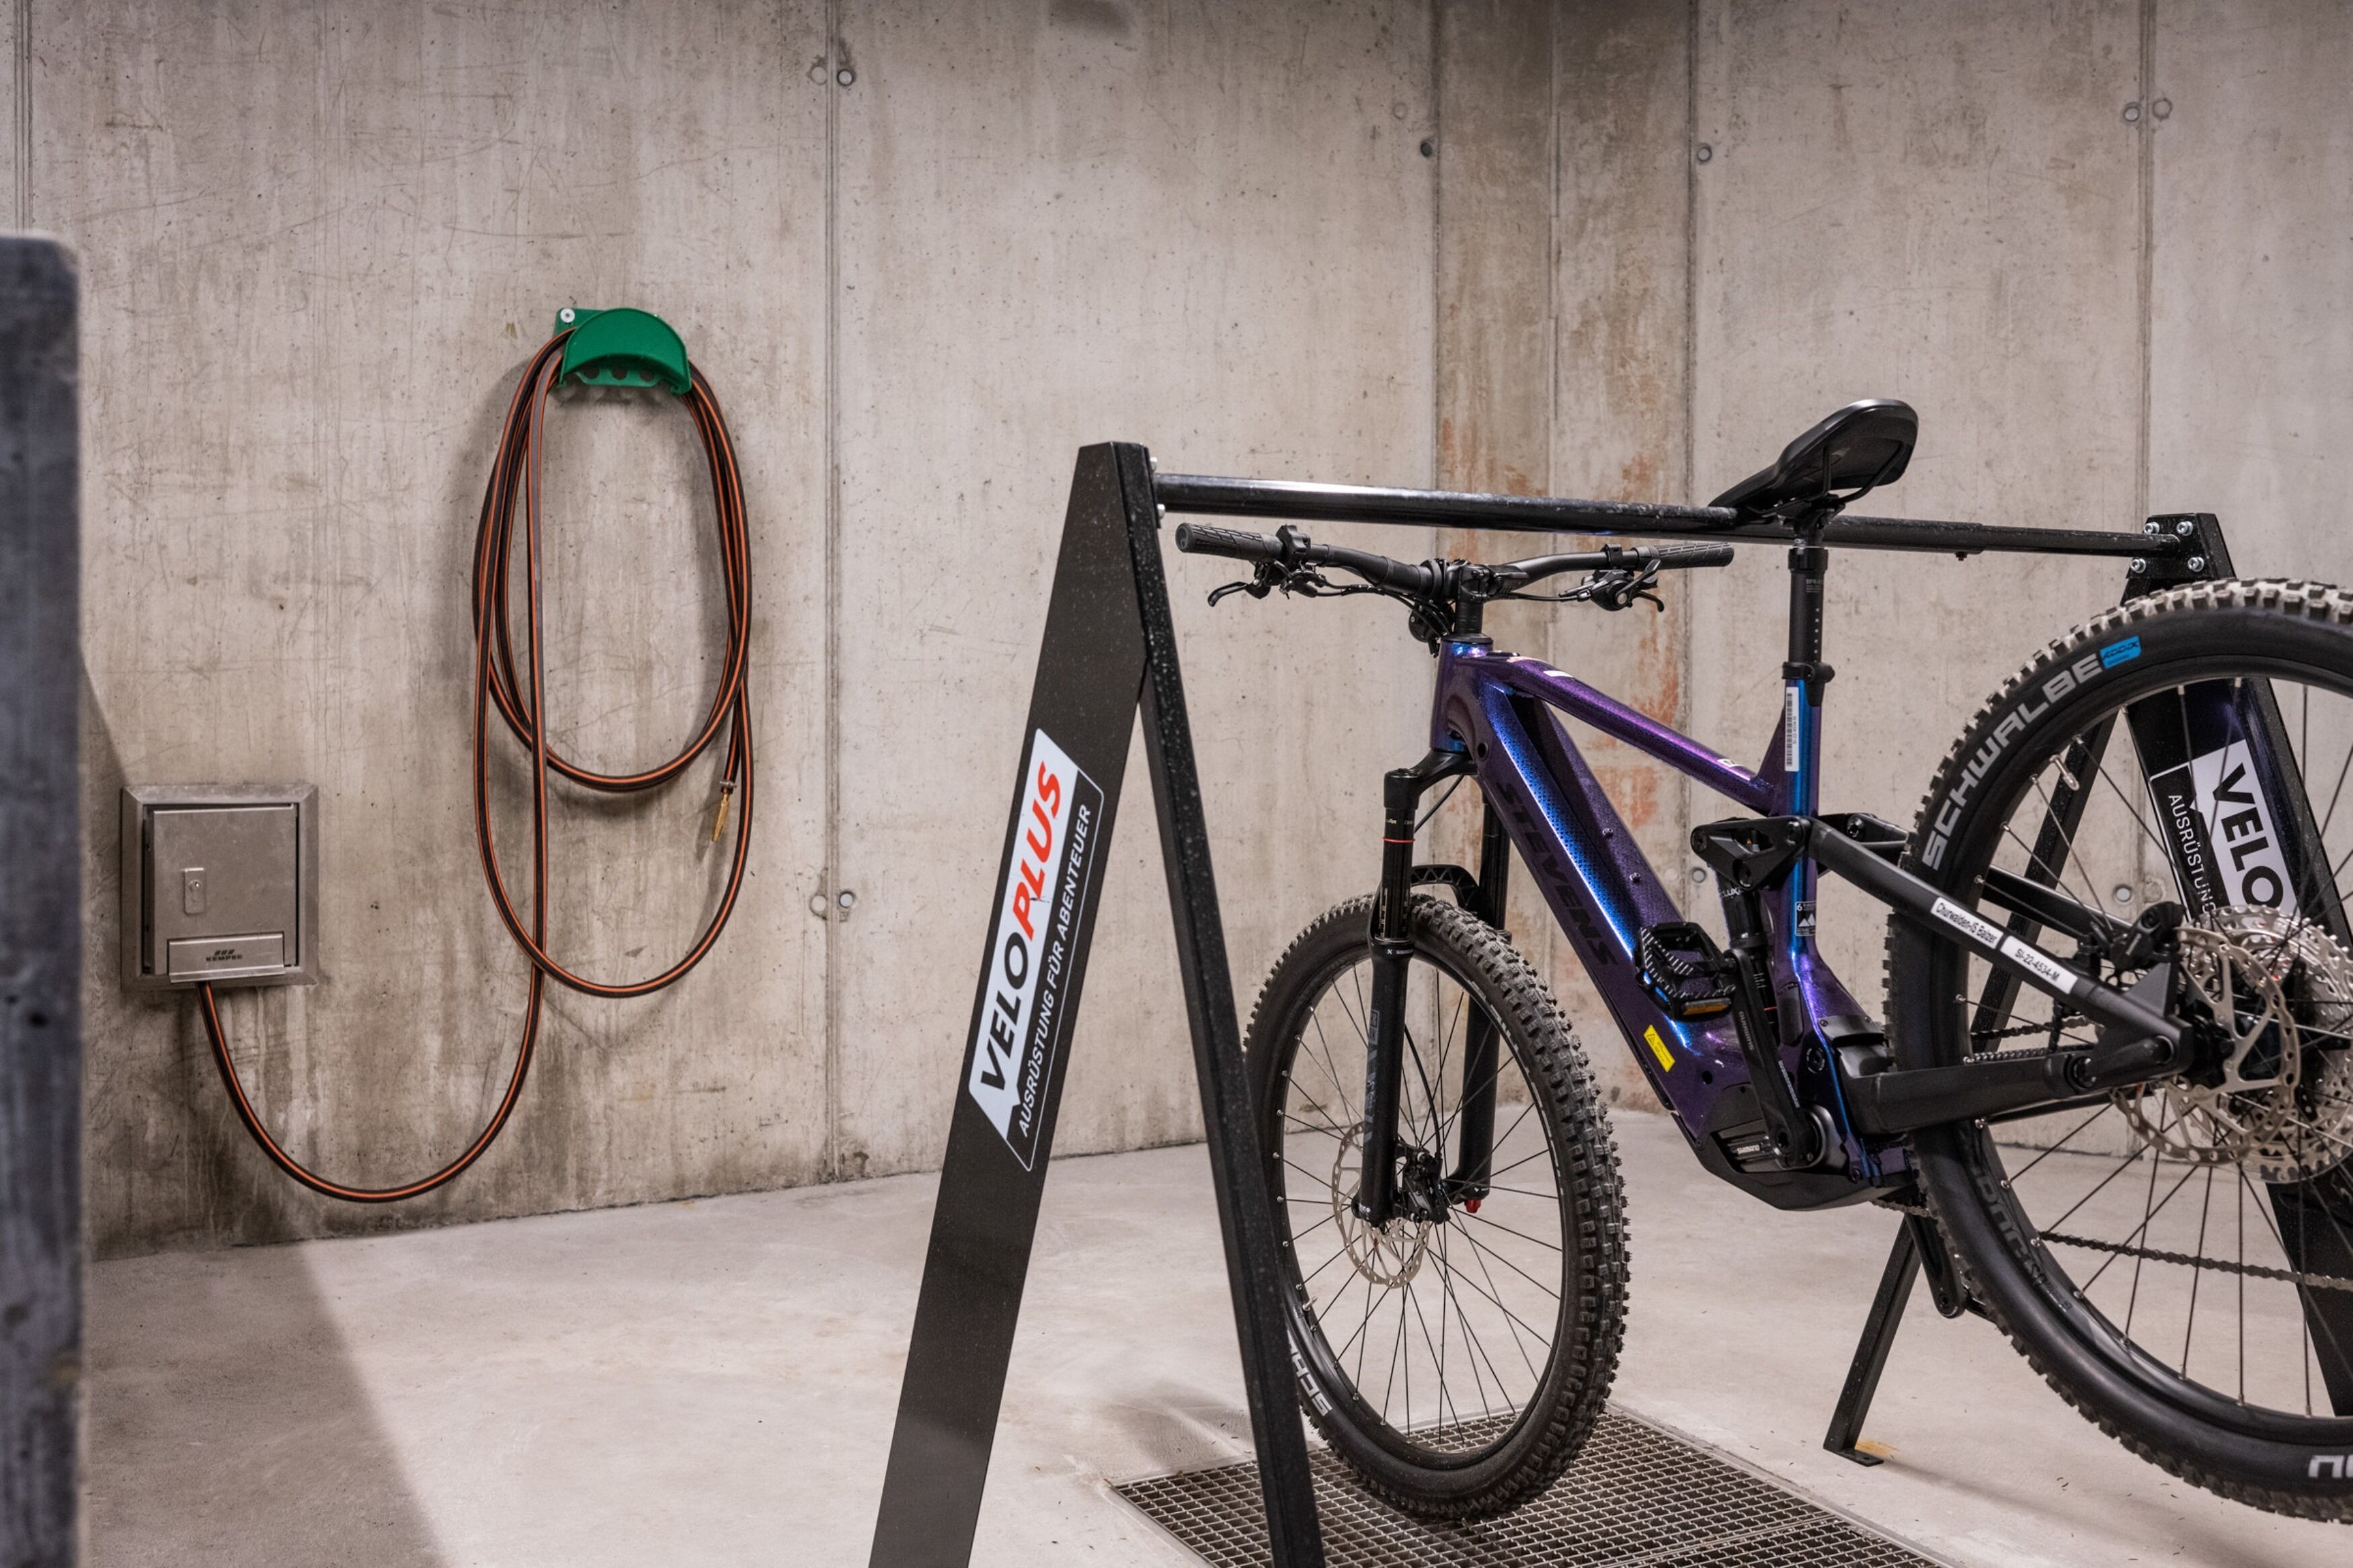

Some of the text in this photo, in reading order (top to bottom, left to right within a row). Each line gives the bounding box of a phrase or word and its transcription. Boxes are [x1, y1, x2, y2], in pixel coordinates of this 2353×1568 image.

[1922, 654, 2103, 871] SCHWALBE
[980, 760, 1061, 1091] VELOPLUS
[1019, 804, 1091, 1138] AUSRÜSTUNG FÜR ABENTEUER
[1496, 782, 1618, 966] STEVENS
[2015, 948, 2060, 983] SI-22-4534-M
